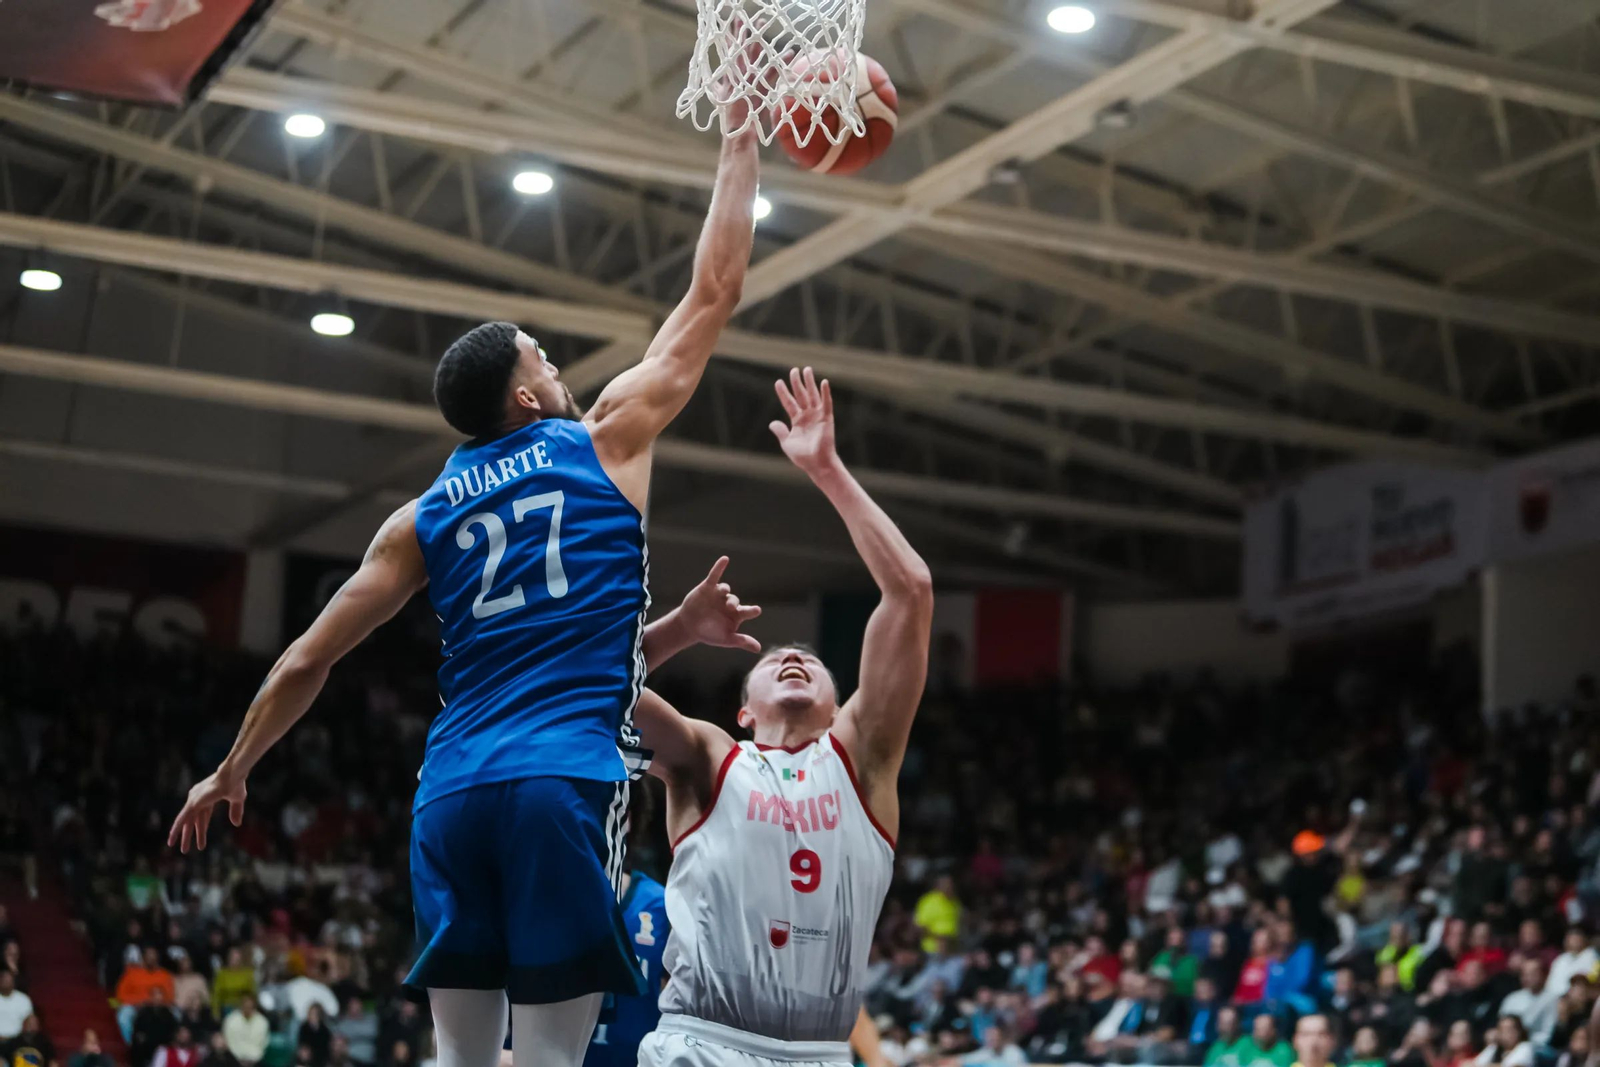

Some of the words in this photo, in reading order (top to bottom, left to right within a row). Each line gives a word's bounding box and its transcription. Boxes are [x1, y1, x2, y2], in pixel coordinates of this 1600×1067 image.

[445, 440, 552, 507] DUARTE
[456, 490, 568, 619] 27
[789, 848, 821, 893] 9
